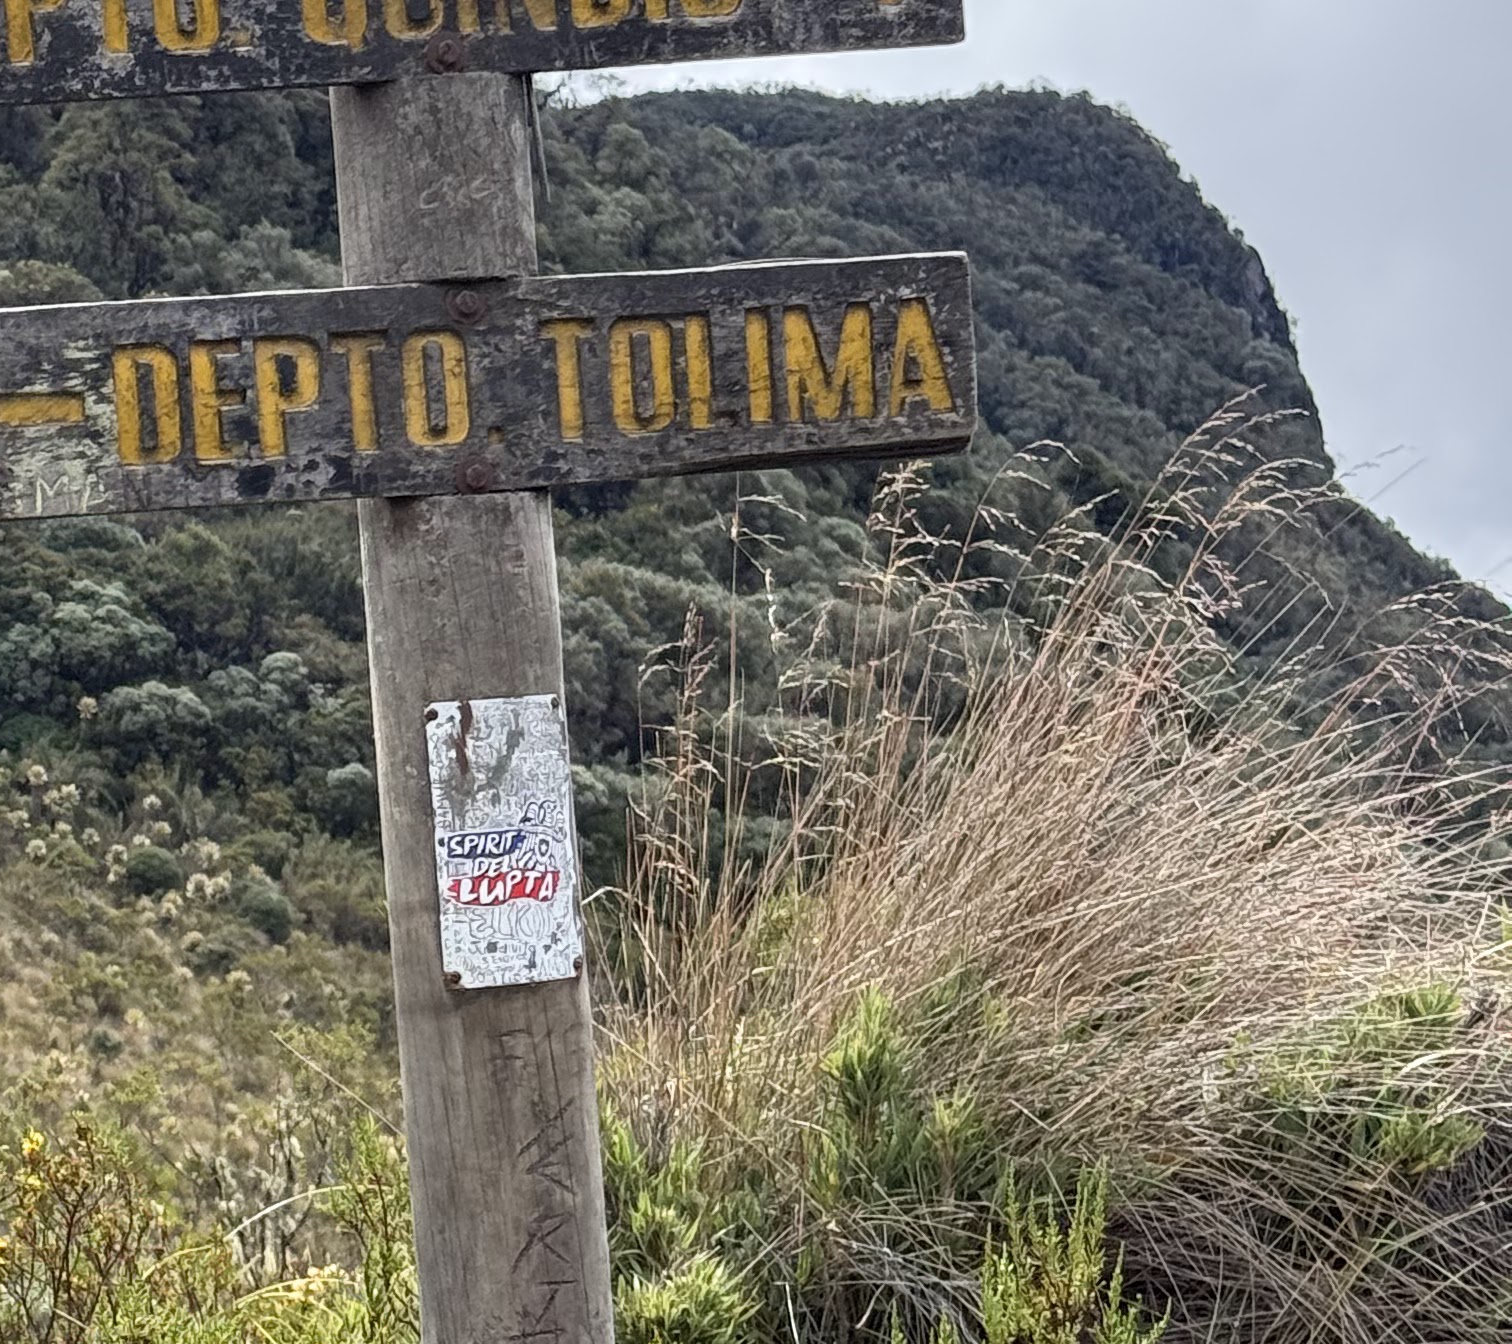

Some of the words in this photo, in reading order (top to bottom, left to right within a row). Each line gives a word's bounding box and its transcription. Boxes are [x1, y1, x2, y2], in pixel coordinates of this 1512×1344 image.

[538, 299, 954, 442] TOLIMA
[449, 831, 515, 856] SPIRIT
[459, 869, 554, 904] LUPTA
